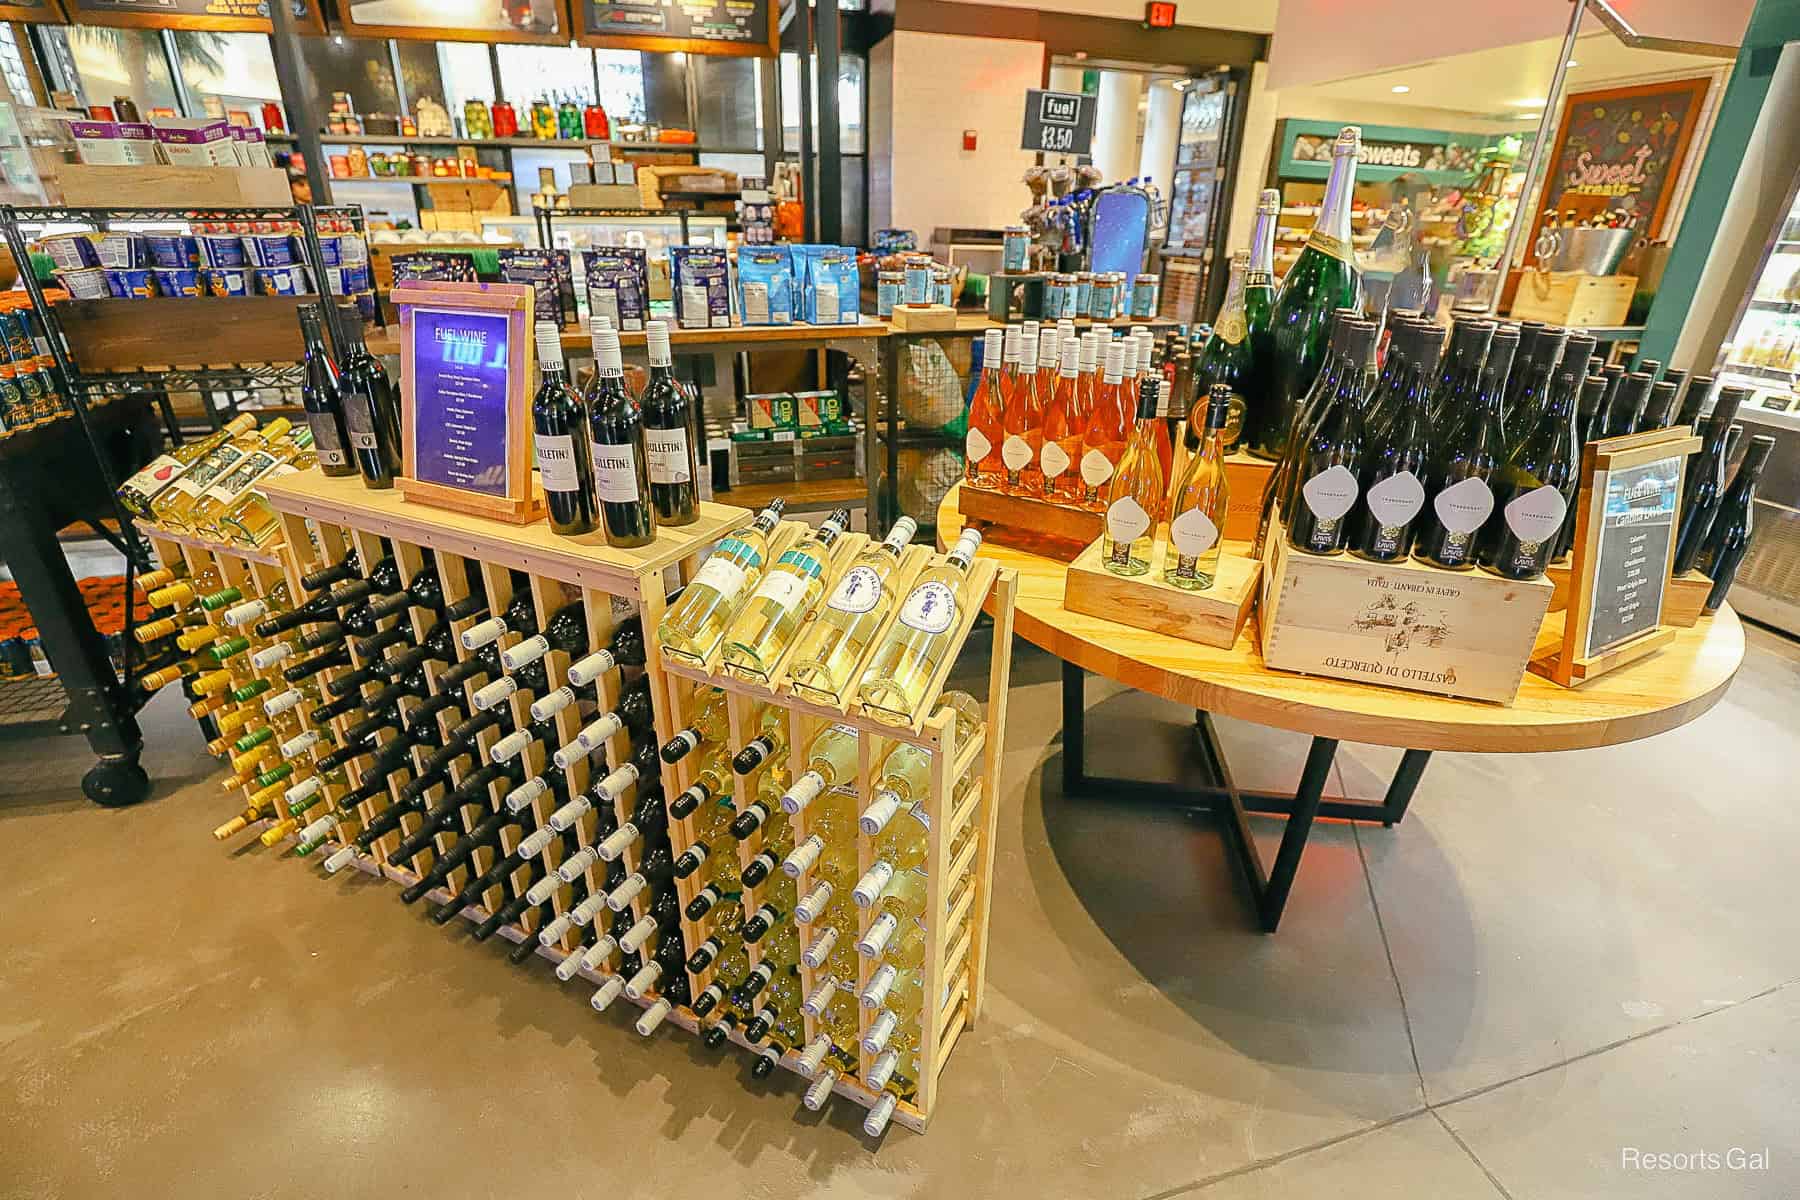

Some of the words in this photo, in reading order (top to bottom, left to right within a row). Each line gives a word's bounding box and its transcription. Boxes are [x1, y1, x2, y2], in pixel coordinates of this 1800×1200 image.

[1047, 98, 1075, 116] fuel
[1041, 126, 1073, 149] $3.50
[1359, 144, 1421, 167] sweets
[1569, 144, 1653, 186] Sweet
[1577, 181, 1630, 197] treats
[435, 327, 458, 343] FUEL
[459, 328, 487, 344] WINE
[1367, 577, 1389, 590] ITALIA
[1395, 582, 1424, 594] CHIANTI
[1425, 585, 1435, 596] IN
[1435, 586, 1461, 599] GREVE
[1324, 656, 1383, 675] QUERCETO
[1387, 665, 1399, 678] DI
[1401, 668, 1457, 685] CASTELLO
